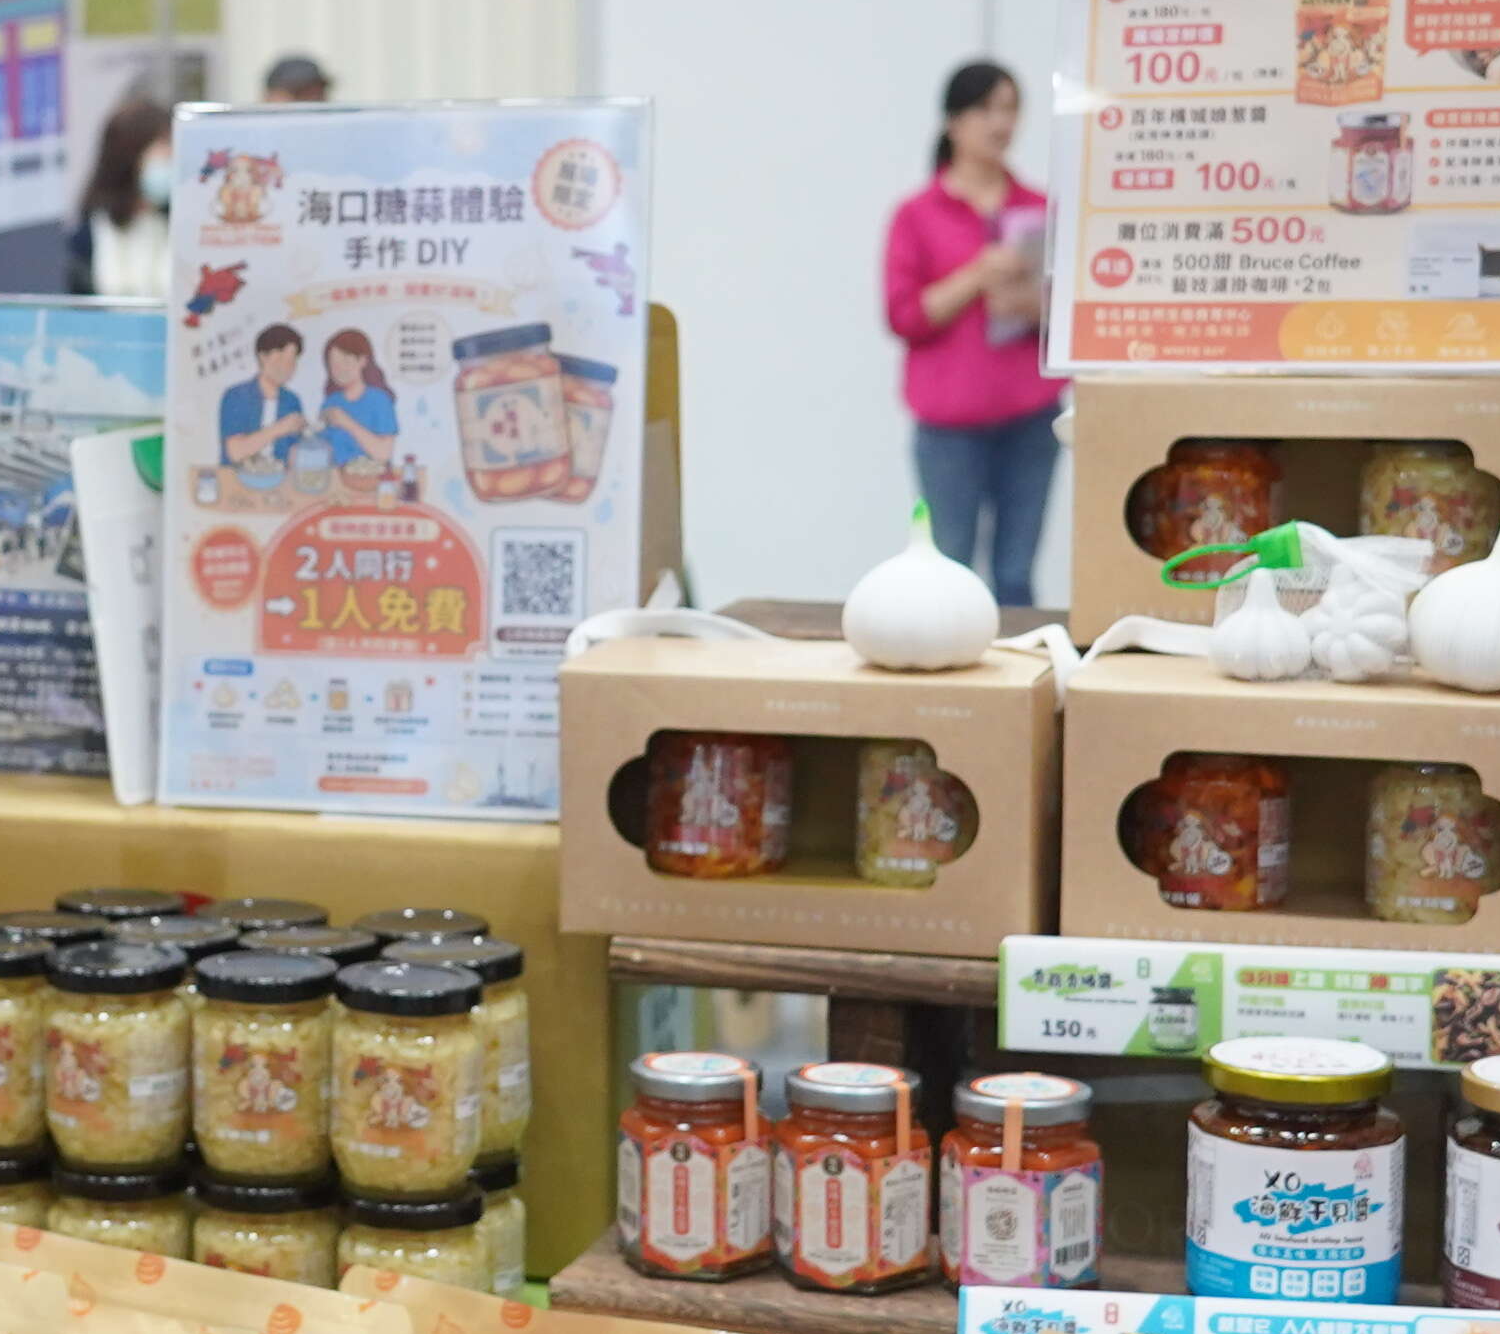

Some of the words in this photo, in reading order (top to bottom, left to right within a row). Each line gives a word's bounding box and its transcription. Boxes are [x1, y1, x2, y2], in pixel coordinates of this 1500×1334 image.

[1126, 51, 1201, 84] 100
[1196, 161, 1261, 191] 100
[1230, 216, 1306, 244] 500
[417, 236, 470, 267] DIY
[1298, 253, 1361, 270] Coffee
[300, 585, 467, 634] 1人免費
[1040, 1018, 1082, 1039] 150
[1262, 1168, 1301, 1193] XO
[1001, 1299, 1028, 1315] XO
